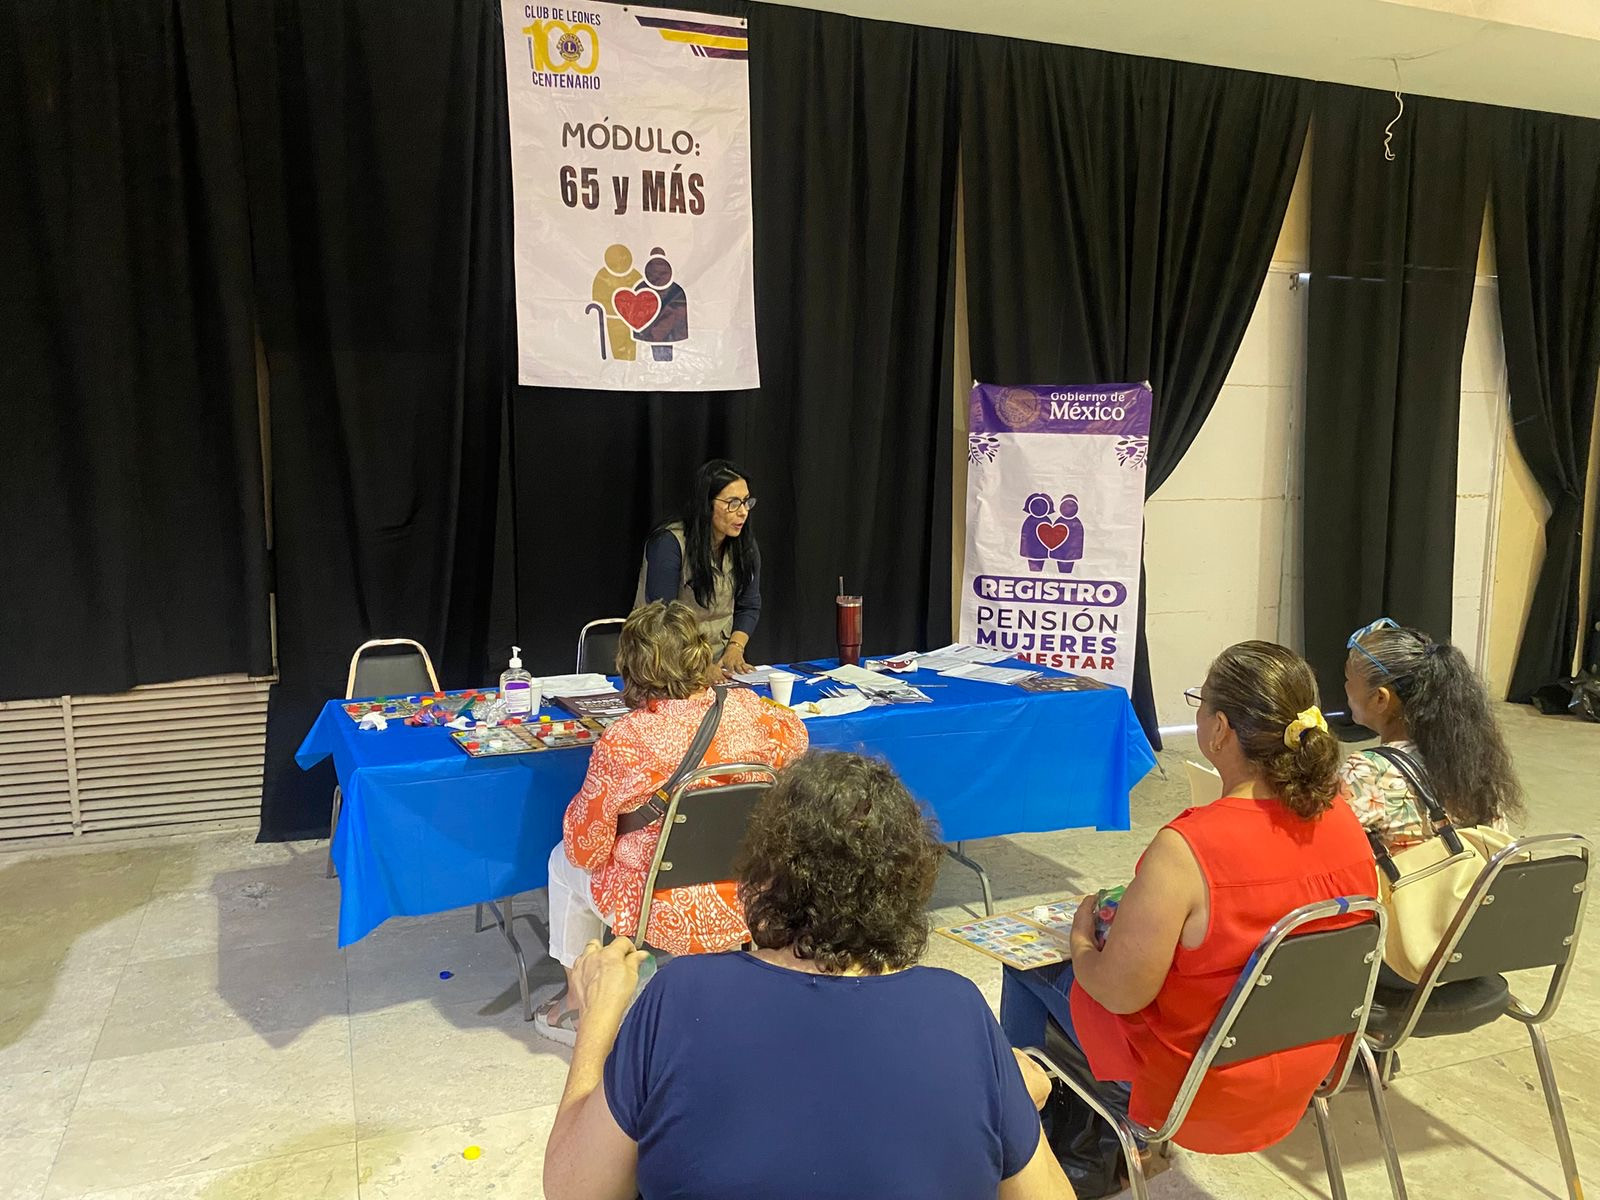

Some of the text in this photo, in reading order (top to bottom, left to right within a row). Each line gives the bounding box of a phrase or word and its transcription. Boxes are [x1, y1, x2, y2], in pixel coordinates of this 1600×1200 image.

[525, 5, 601, 26] CLUB DE LEONES
[522, 19, 600, 75] 100
[532, 71, 601, 90] CENTENARIO
[562, 116, 701, 156] MÓDULO:
[559, 163, 706, 215] 65 y MÁS
[1050, 391, 1125, 402] Gobierno de
[1049, 401, 1125, 421] México
[980, 578, 1118, 604] REGISTRO
[977, 605, 1118, 634] PENSIÓN
[976, 628, 1117, 655] MUJERES
